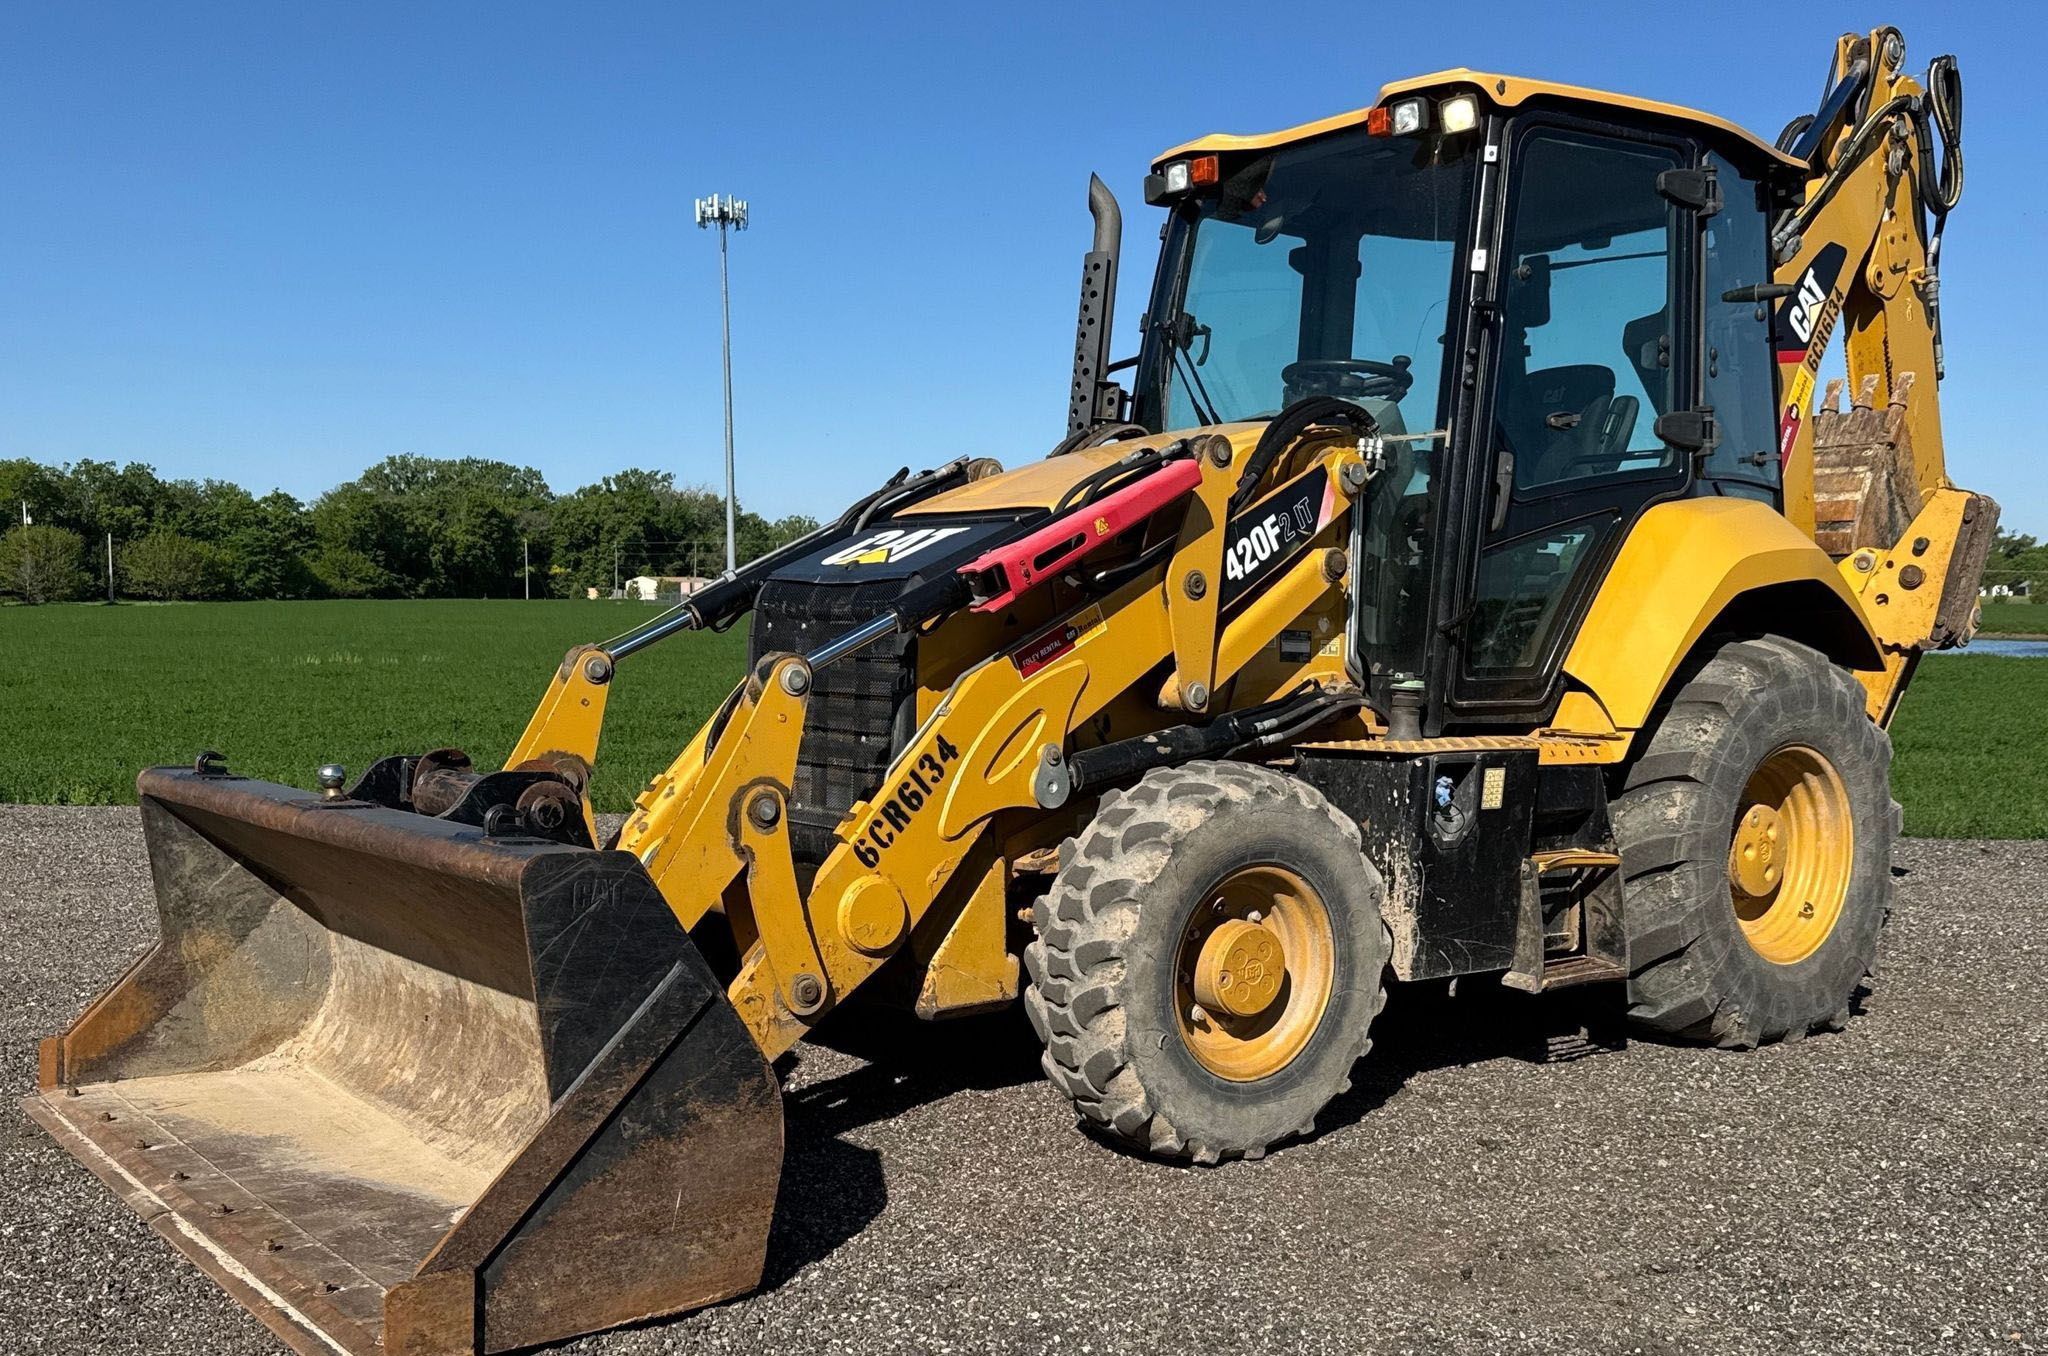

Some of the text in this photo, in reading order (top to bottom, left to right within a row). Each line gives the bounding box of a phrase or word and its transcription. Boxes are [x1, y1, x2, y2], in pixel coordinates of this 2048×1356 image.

[1789, 267, 1827, 343] CAT
[1293, 496, 1313, 530] IT
[820, 527, 971, 566] CAT
[1022, 652, 1040, 667] FOLEY
[1040, 640, 1062, 656] RENTAL
[853, 733, 959, 869] 6CR6134
